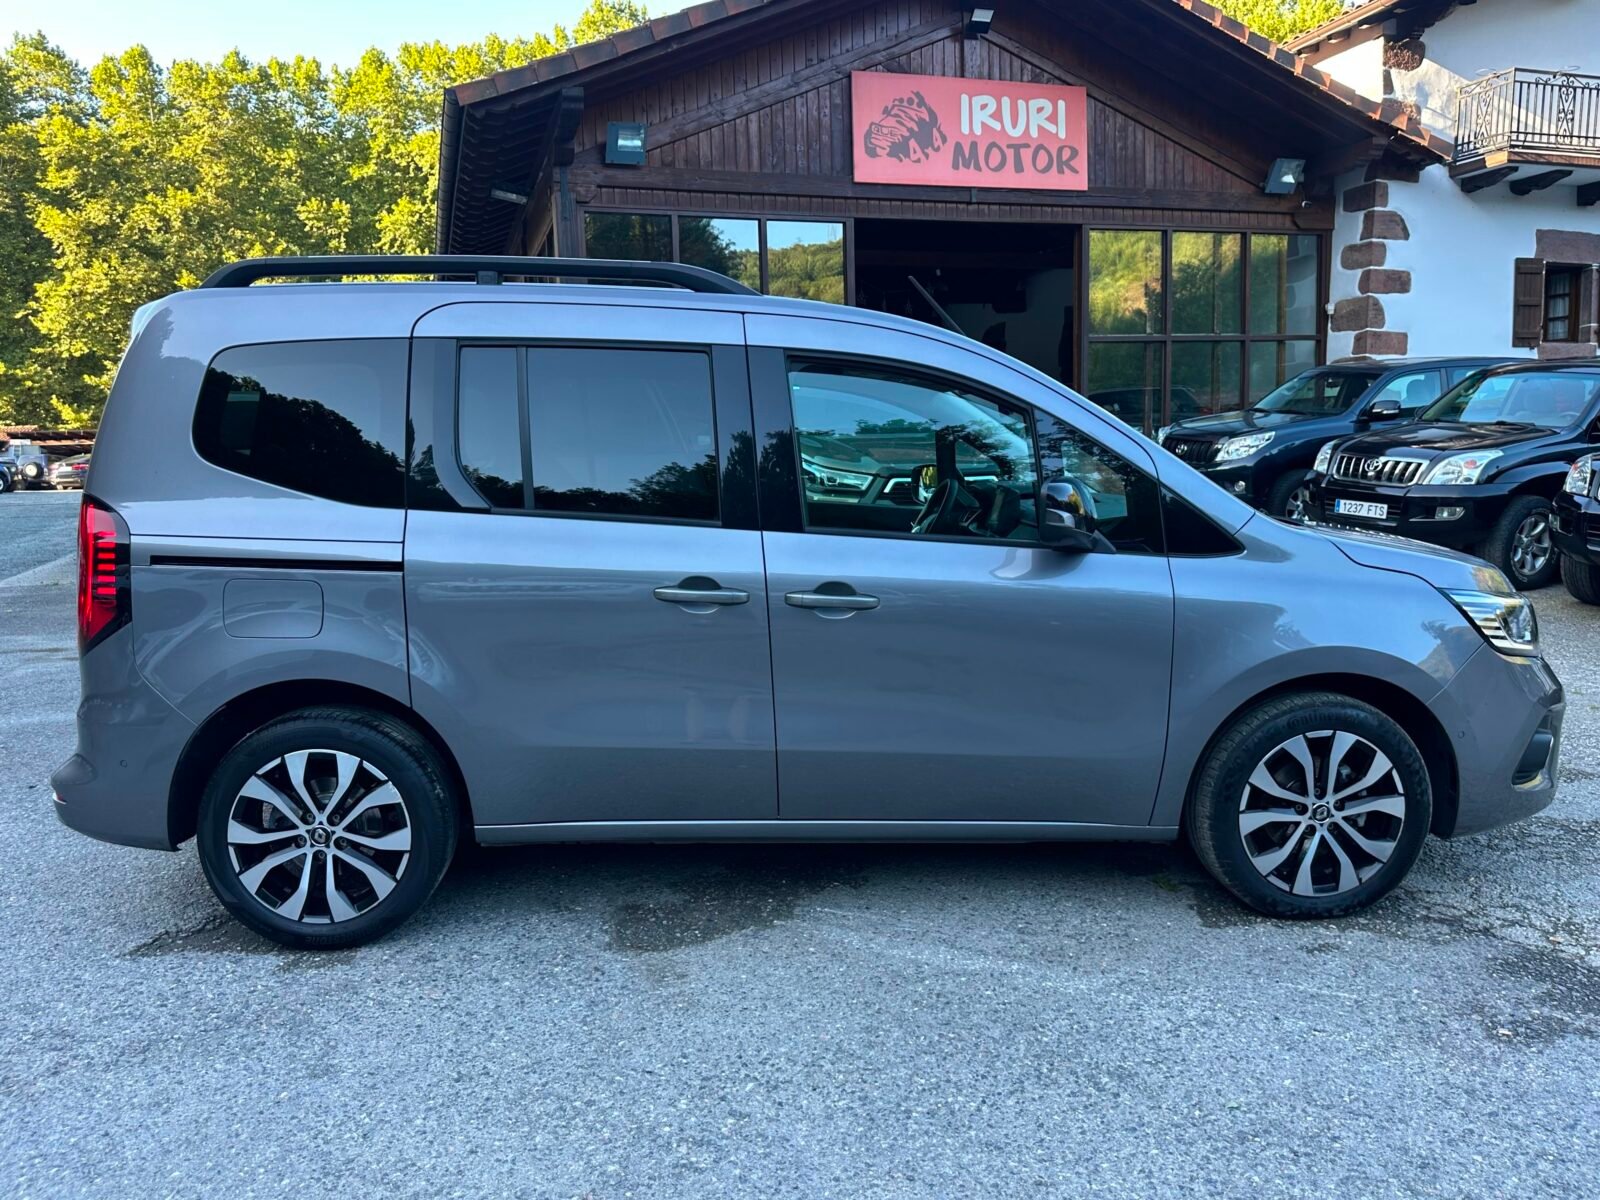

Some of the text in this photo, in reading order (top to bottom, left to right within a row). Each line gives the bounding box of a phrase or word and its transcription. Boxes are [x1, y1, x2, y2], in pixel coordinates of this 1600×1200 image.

[960, 93, 1066, 140] IRURI
[952, 141, 1080, 175] MOTOR
[1343, 502, 1385, 517] 1237 FTS
